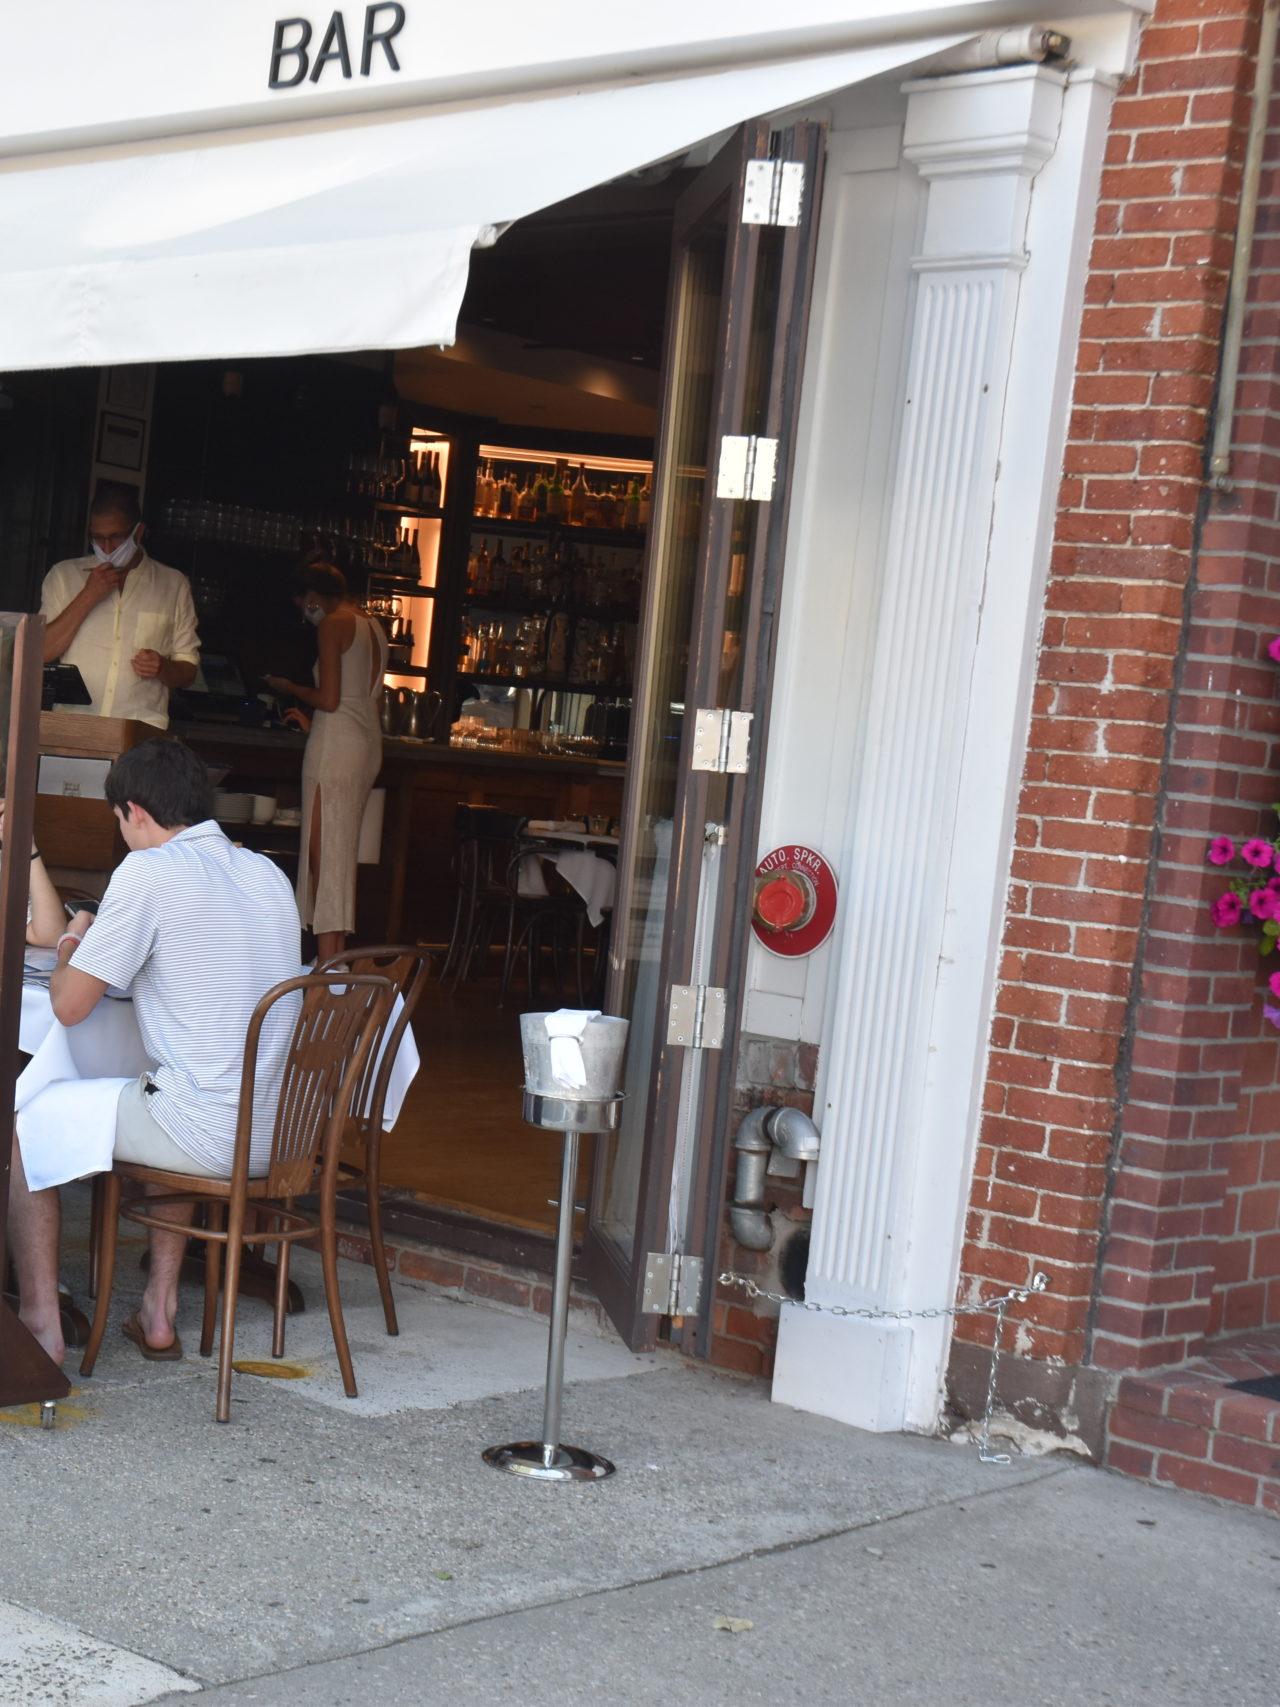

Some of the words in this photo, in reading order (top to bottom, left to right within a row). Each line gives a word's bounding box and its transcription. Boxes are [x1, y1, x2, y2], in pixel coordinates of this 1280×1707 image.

[267, 1, 406, 89] BAR
[759, 849, 790, 874] AUTO.
[794, 847, 822, 875] SPKR.
